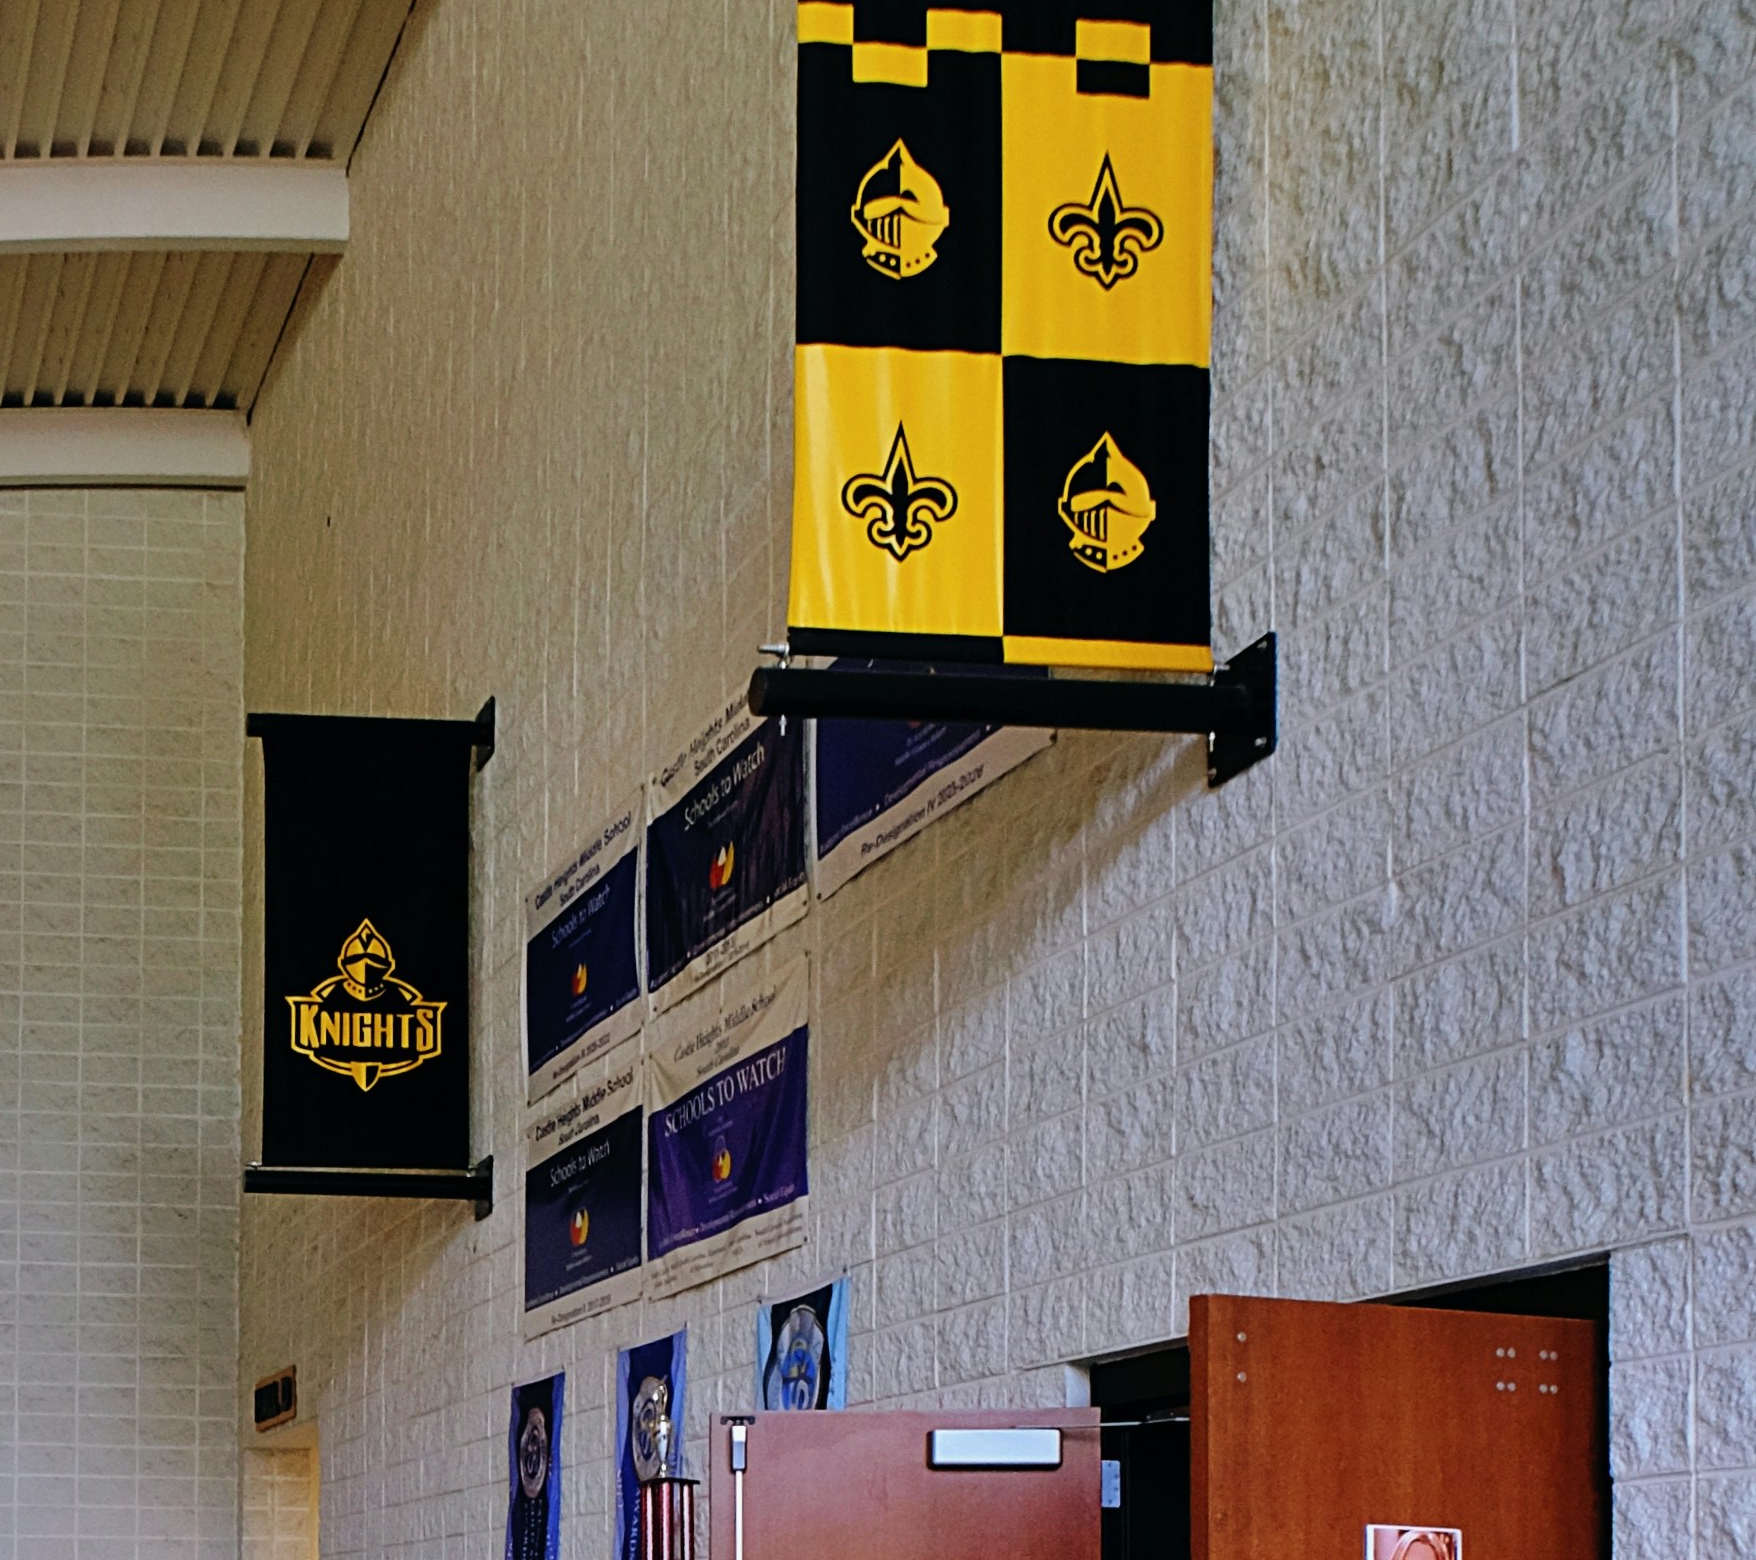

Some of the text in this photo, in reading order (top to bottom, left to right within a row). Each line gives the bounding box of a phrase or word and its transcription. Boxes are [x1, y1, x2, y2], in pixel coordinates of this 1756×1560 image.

[694, 717, 750, 777] South Carolina
[684, 783, 720, 831] Schools
[721, 775, 731, 797] to
[733, 741, 764, 785] Watch
[604, 811, 631, 846] School
[552, 914, 578, 948] Schools
[300, 1004, 434, 1052] KNIGHTS
[674, 1042, 694, 1062] Castle
[696, 1024, 722, 1051] Heights
[724, 1003, 752, 1030] Middle
[715, 1046, 740, 1068] Carolina
[607, 1066, 634, 1096] School
[664, 1046, 786, 1137] SCHOOLS TO WATCH
[550, 1157, 577, 1188] Schools
